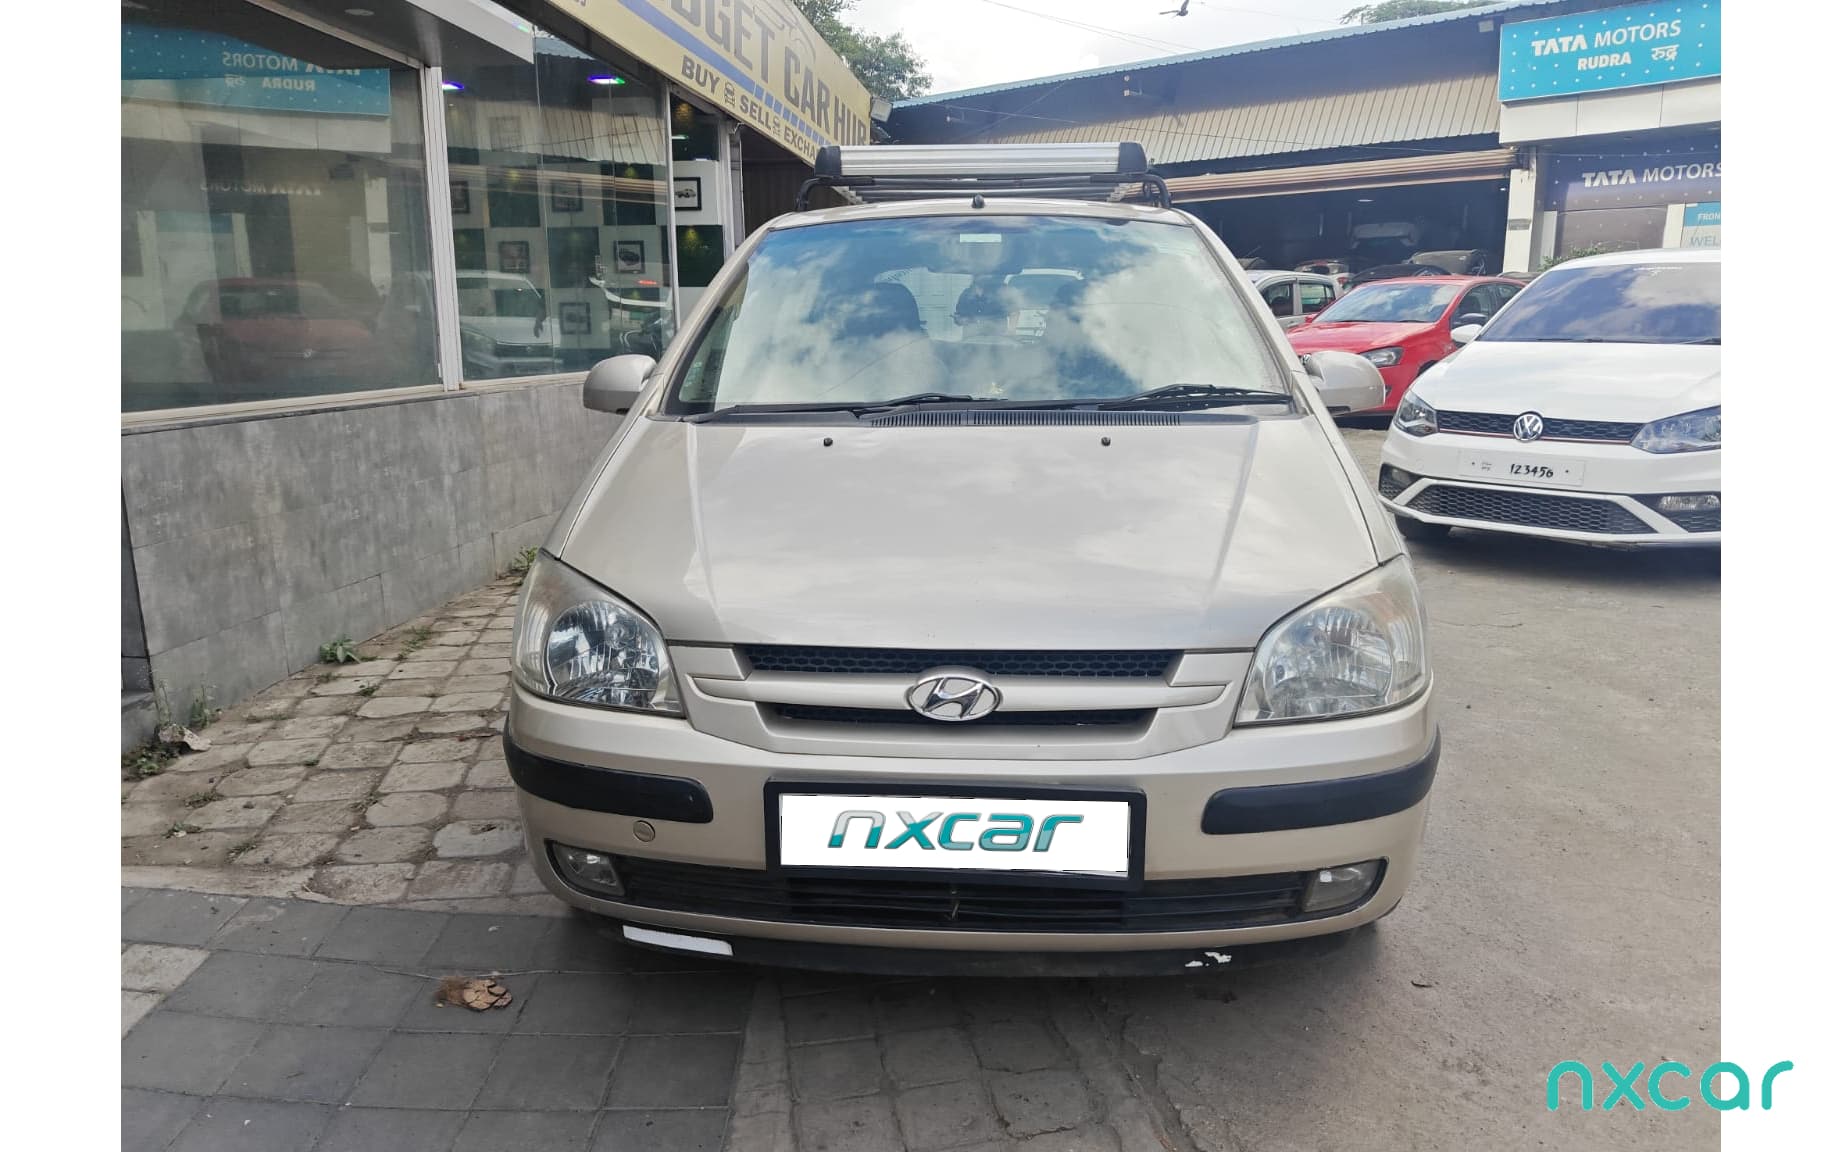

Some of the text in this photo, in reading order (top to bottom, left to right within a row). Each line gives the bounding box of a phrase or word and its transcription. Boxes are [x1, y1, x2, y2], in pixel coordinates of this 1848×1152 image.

[1531, 19, 1682, 57] TATA MOTORS
[1577, 51, 1632, 71] RUDRA
[1651, 44, 1680, 62] रुद्र
[681, 54, 721, 95] BUY
[739, 95, 772, 130] SELL
[784, 46, 831, 135] CAR
[1582, 162, 1721, 188] TATA MOTORS
[1510, 463, 1554, 478] 123456
